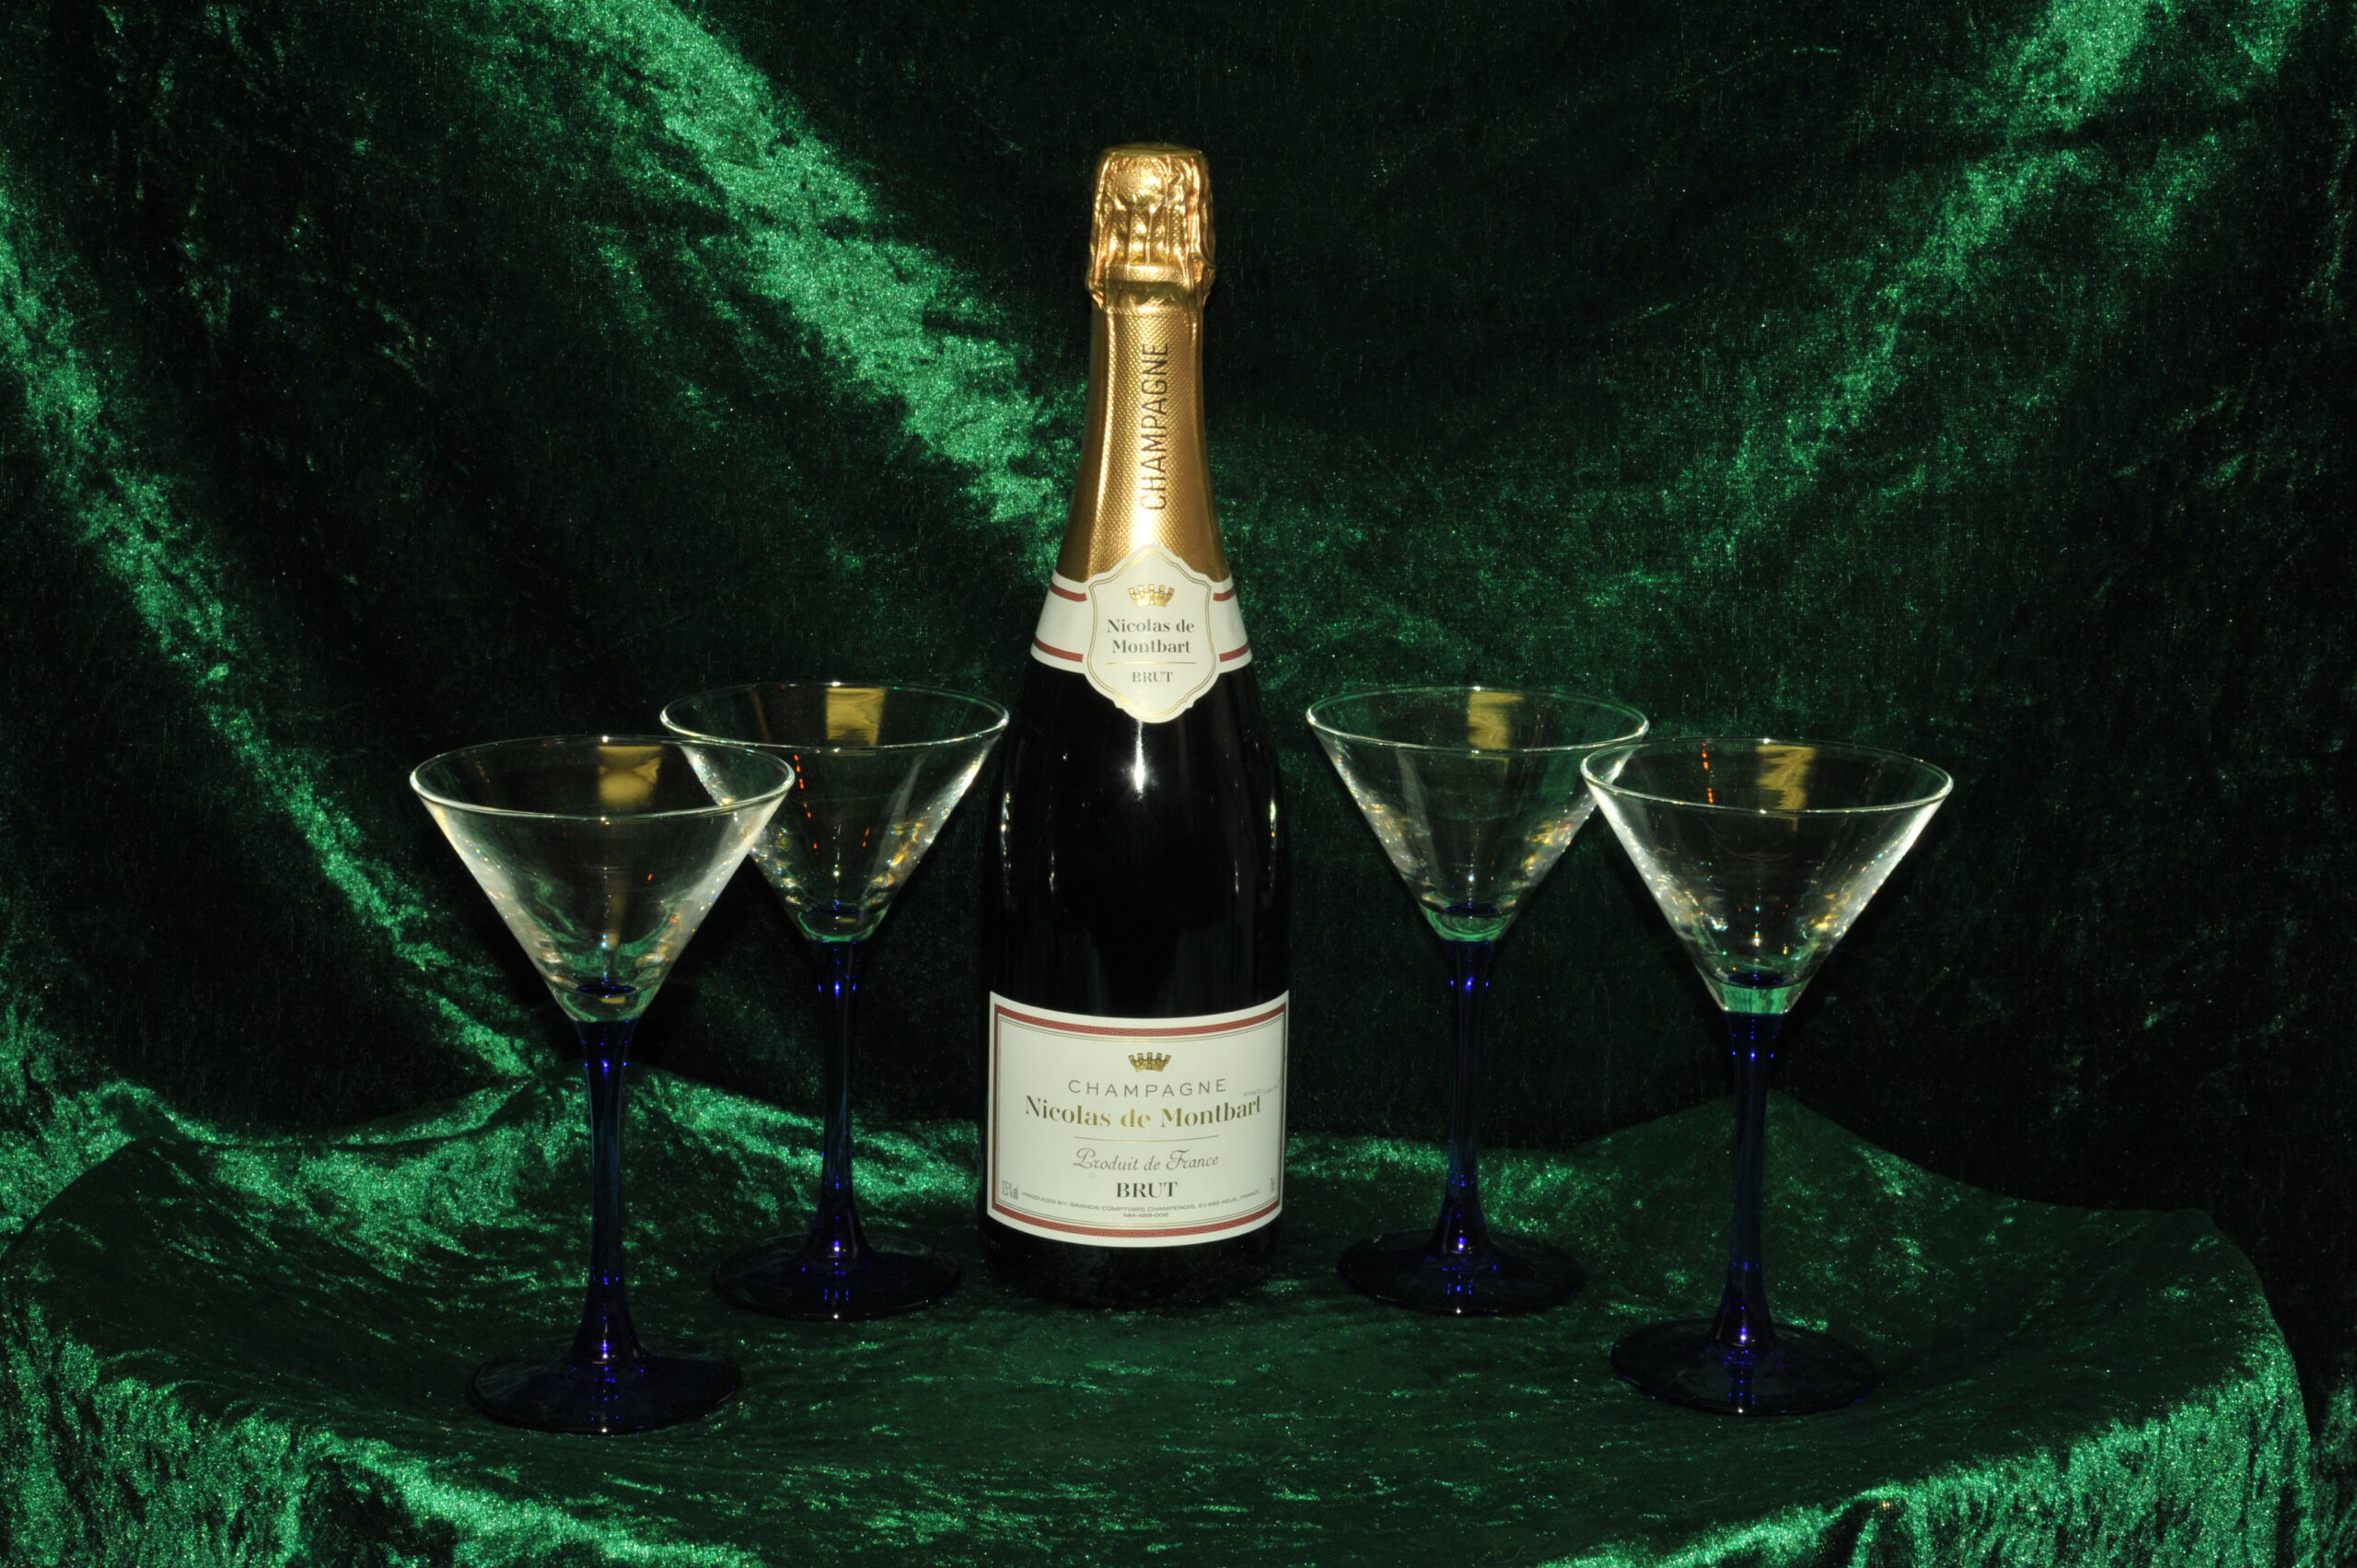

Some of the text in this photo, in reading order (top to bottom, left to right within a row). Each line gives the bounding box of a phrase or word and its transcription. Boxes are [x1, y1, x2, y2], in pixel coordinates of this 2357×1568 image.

[1140, 343, 1170, 511] CHAMPAGNE
[1107, 618, 1195, 634] Nicolas de
[1111, 640, 1191, 654] Montbart
[1132, 671, 1174, 683] BRUT
[1068, 1078, 1227, 1098] CHAMPAGNE
[1025, 1095, 1262, 1129] Nicolas de Montbart
[1073, 1147, 1220, 1171] Produit de France
[1022, 1191, 1056, 1204] PRODUCED
[1116, 1181, 1178, 1198] BRUT
